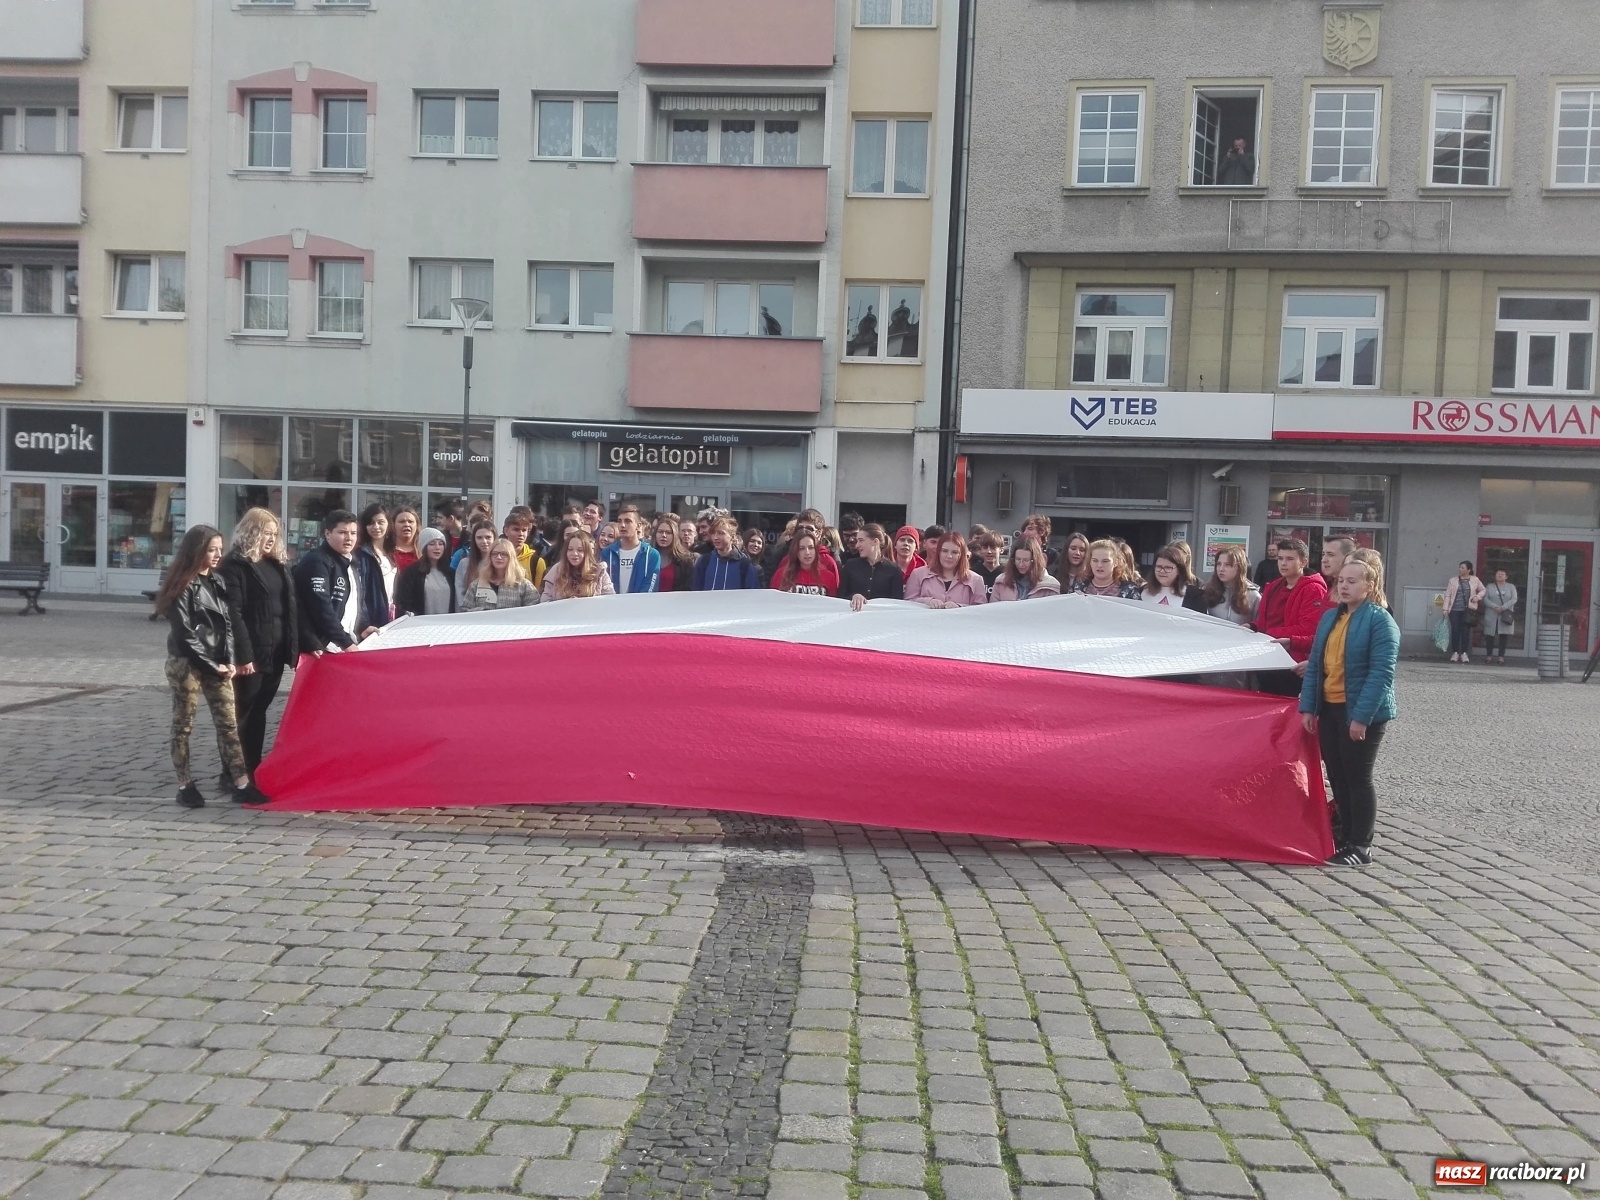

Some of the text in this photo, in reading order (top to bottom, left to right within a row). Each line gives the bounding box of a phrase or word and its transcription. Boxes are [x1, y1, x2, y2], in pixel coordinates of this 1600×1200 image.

[1110, 398, 1158, 415] TEB
[1108, 418, 1157, 426] EDUKACJA
[15, 424, 93, 454] empik
[433, 449, 489, 462] empi.com
[610, 443, 719, 469] gelatopiu
